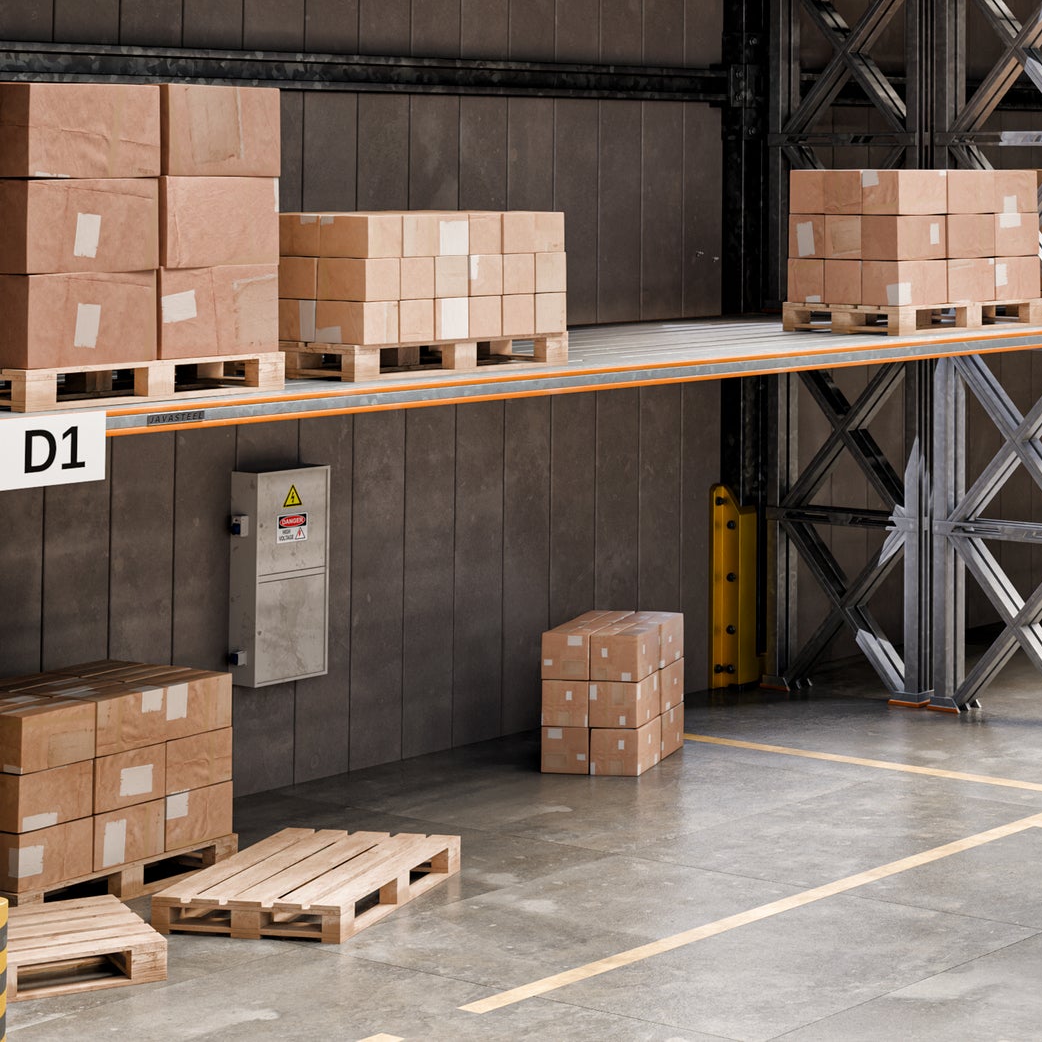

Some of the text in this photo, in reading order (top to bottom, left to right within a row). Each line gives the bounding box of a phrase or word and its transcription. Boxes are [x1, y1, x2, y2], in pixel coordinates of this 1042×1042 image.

[149, 411, 204, 424] JAVASTEEL
[24, 425, 86, 474] D1
[282, 516, 304, 525] DANGER
